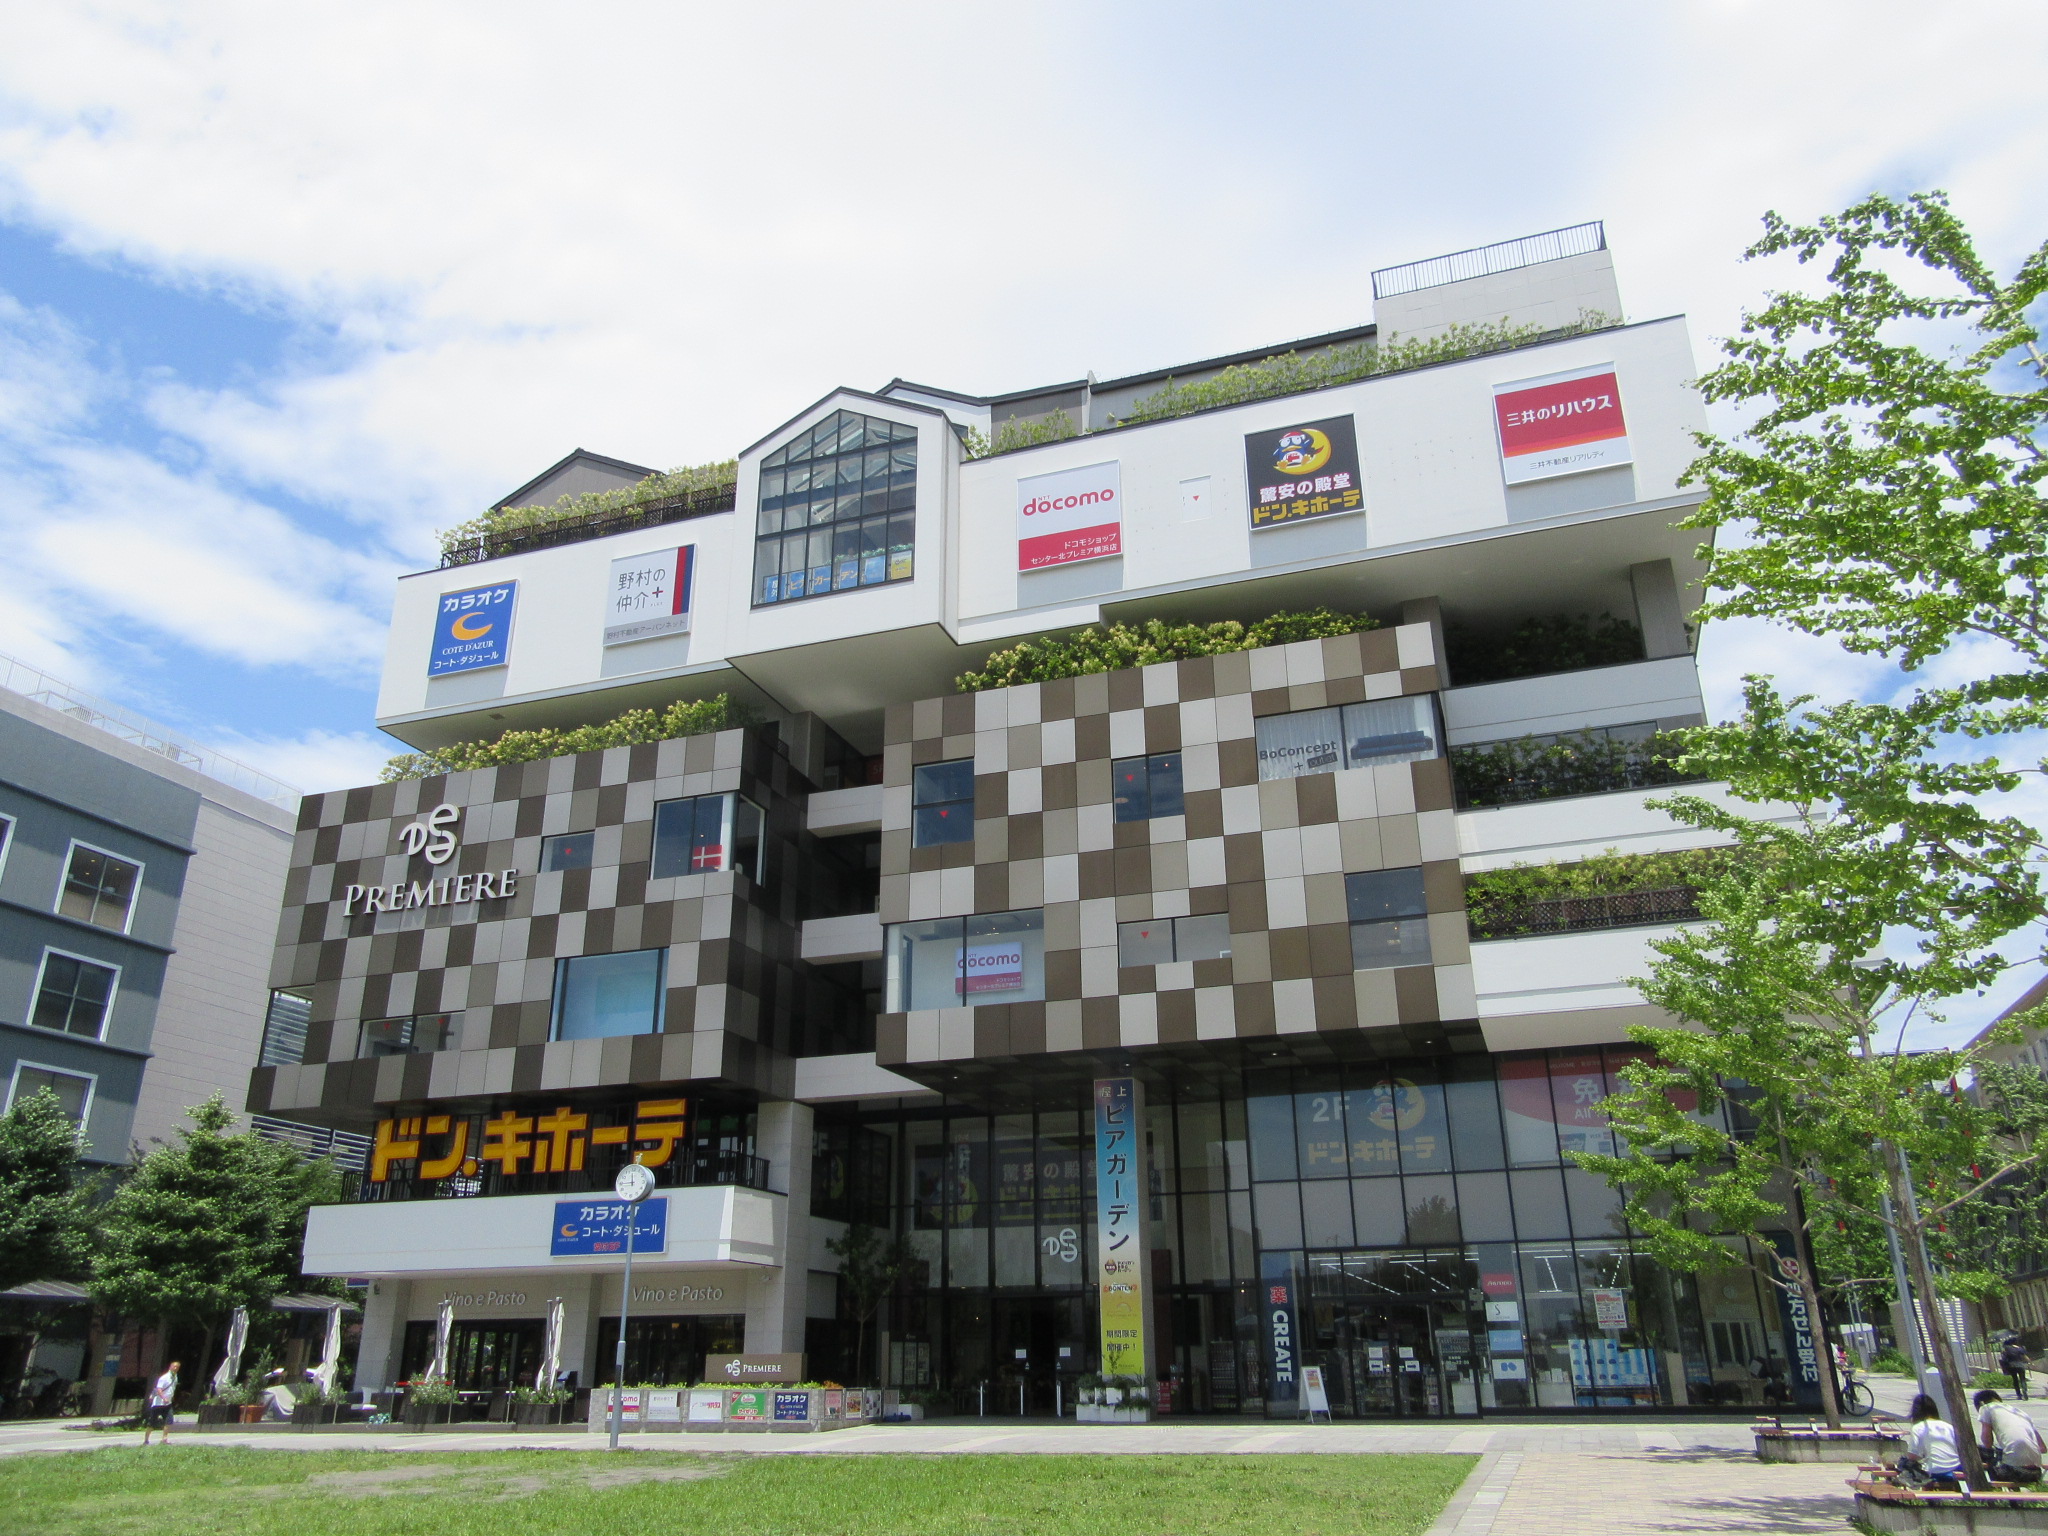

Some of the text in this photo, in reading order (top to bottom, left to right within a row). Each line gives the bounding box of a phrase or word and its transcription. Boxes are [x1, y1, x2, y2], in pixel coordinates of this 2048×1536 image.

[1506, 394, 1613, 428] 三井のリハウス
[1259, 472, 1351, 503] 驚安の殿堂
[1022, 488, 1115, 517] docomo
[1063, 532, 1117, 550] ドコモショップ
[1030, 543, 1118, 565] センター北プレミア横浜店
[617, 567, 667, 591] 野村の
[443, 588, 510, 613] カラオケ
[606, 619, 686, 640] 野村不動産アーバンネット
[434, 651, 500, 670] コート・ダジュール
[1259, 740, 1337, 761] BoConcept
[342, 868, 519, 918] PREMIERE
[1101, 1085, 1128, 1099] 屋上
[1311, 1095, 1351, 1123] 2F
[1104, 1103, 1130, 1252] ビアガーデン
[579, 1204, 640, 1222] カラオケ
[443, 1290, 473, 1306] Vino
[486, 1290, 527, 1306] Pasto
[633, 1285, 724, 1302] Vino e Pasto
[1272, 1308, 1294, 1383] CREATE
[742, 1363, 782, 1374] PREMIERE
[776, 1394, 807, 1403] カラオケ
